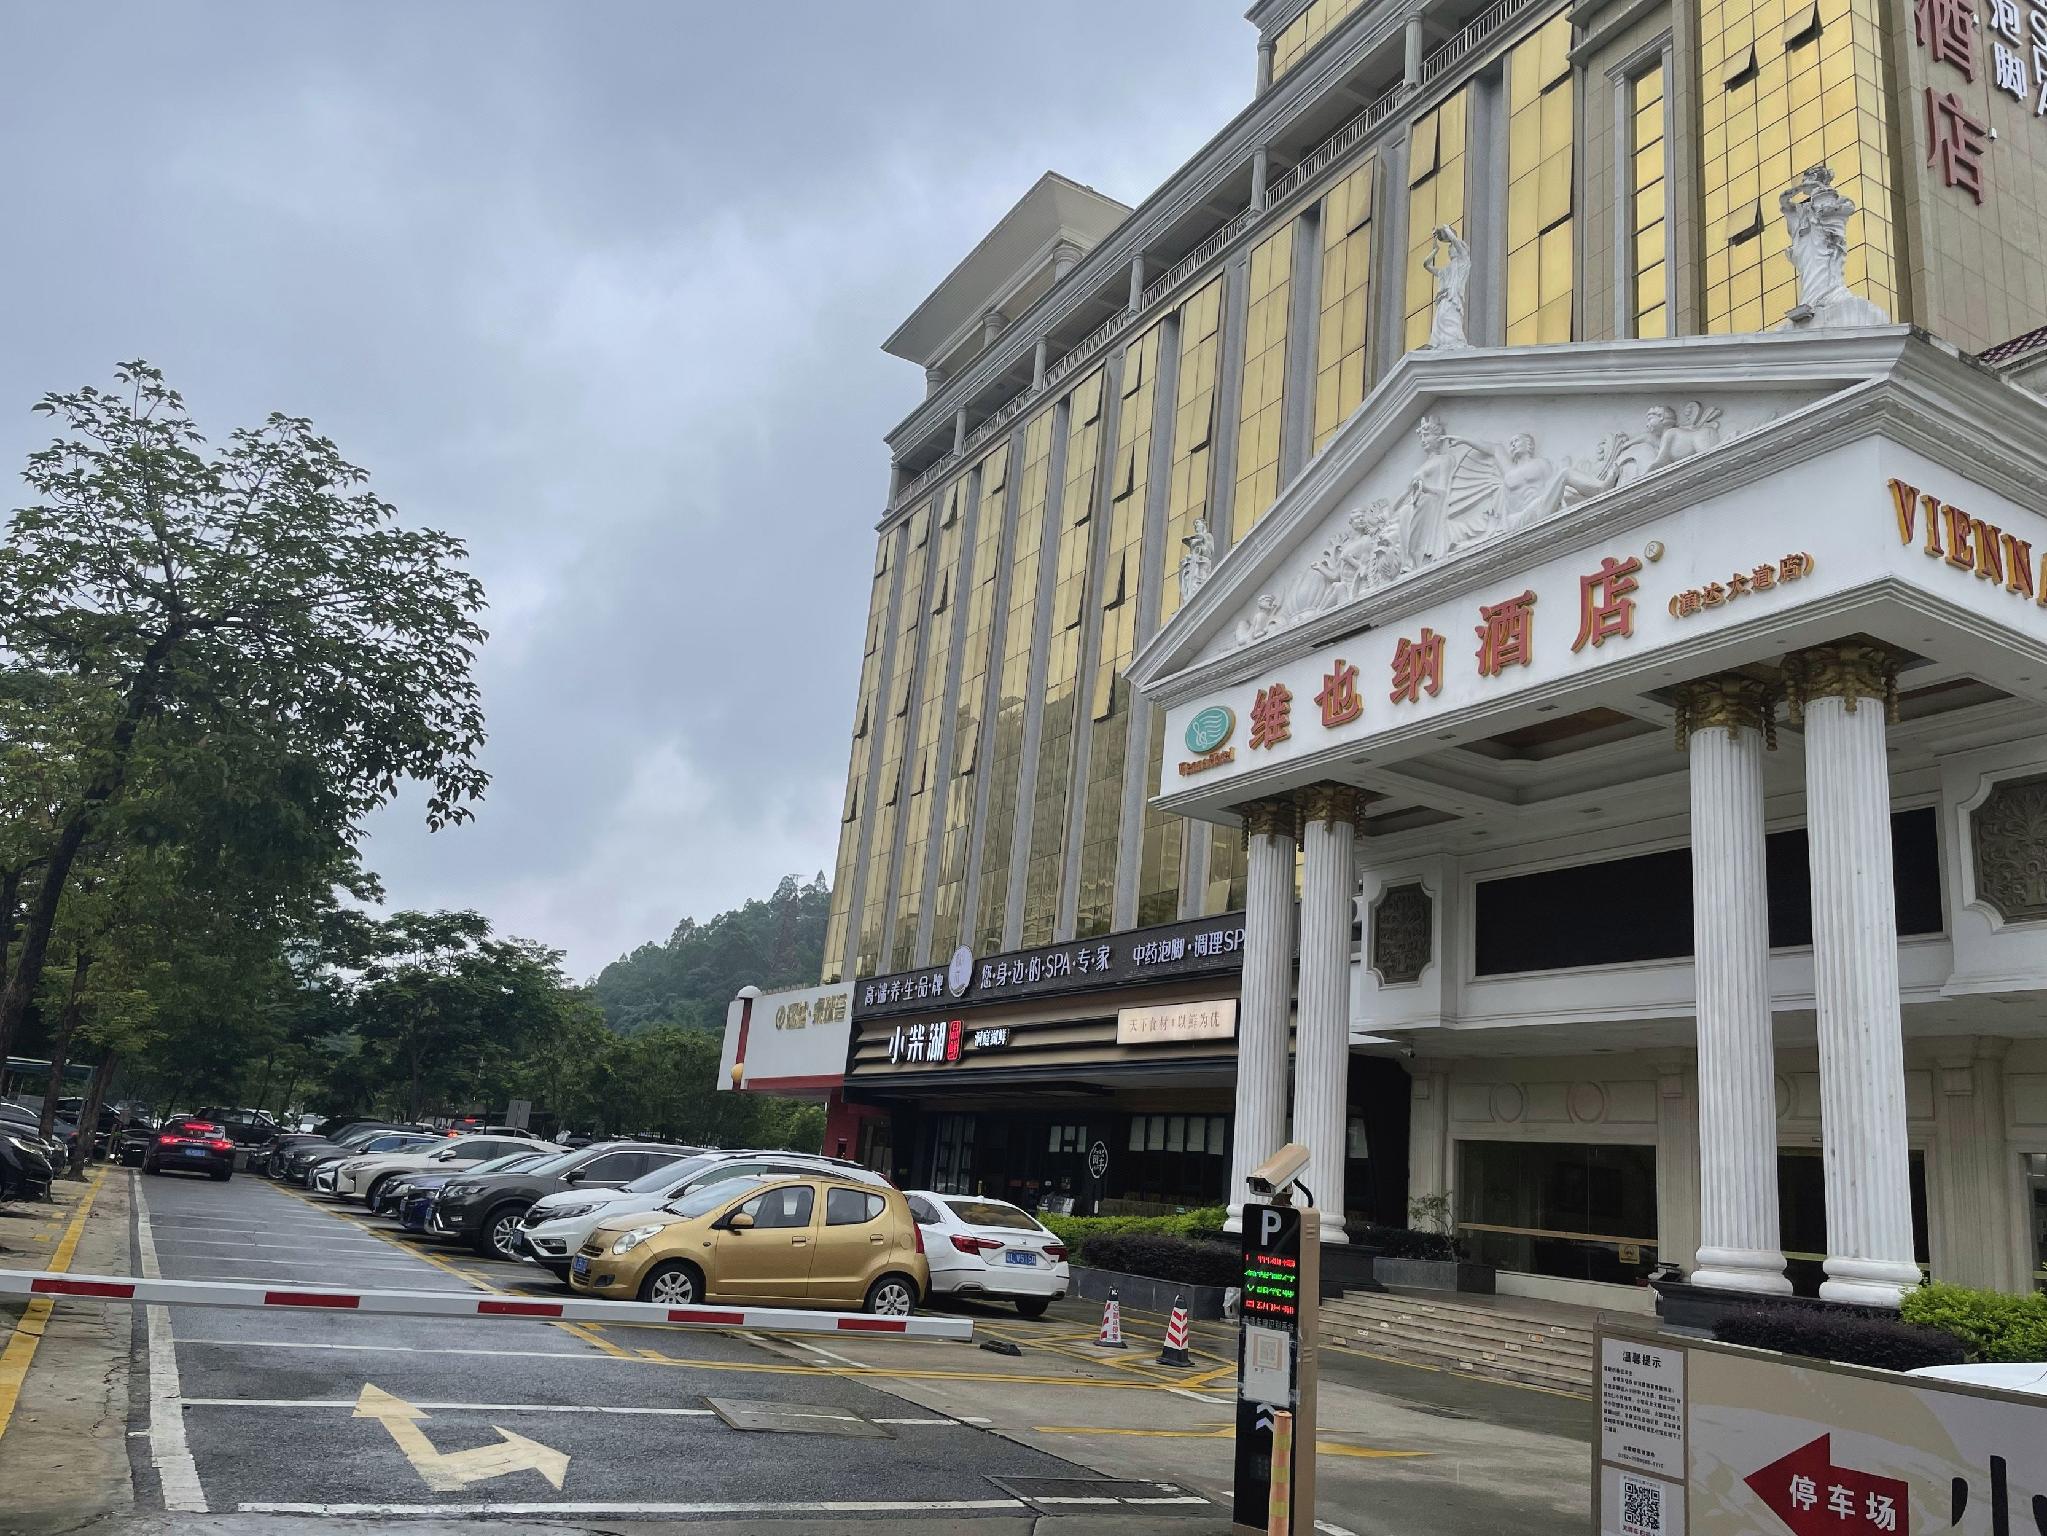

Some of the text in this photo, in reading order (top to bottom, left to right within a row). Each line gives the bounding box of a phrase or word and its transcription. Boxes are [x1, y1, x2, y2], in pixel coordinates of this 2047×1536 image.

[1888, 478, 2047, 609] VIENN
[1248, 555, 1644, 752] 维也纳酒店
[1260, 1209, 1282, 1246] P
[1622, 1351, 1662, 1369] 温馨提示
[1789, 1473, 1896, 1531] 停车场
